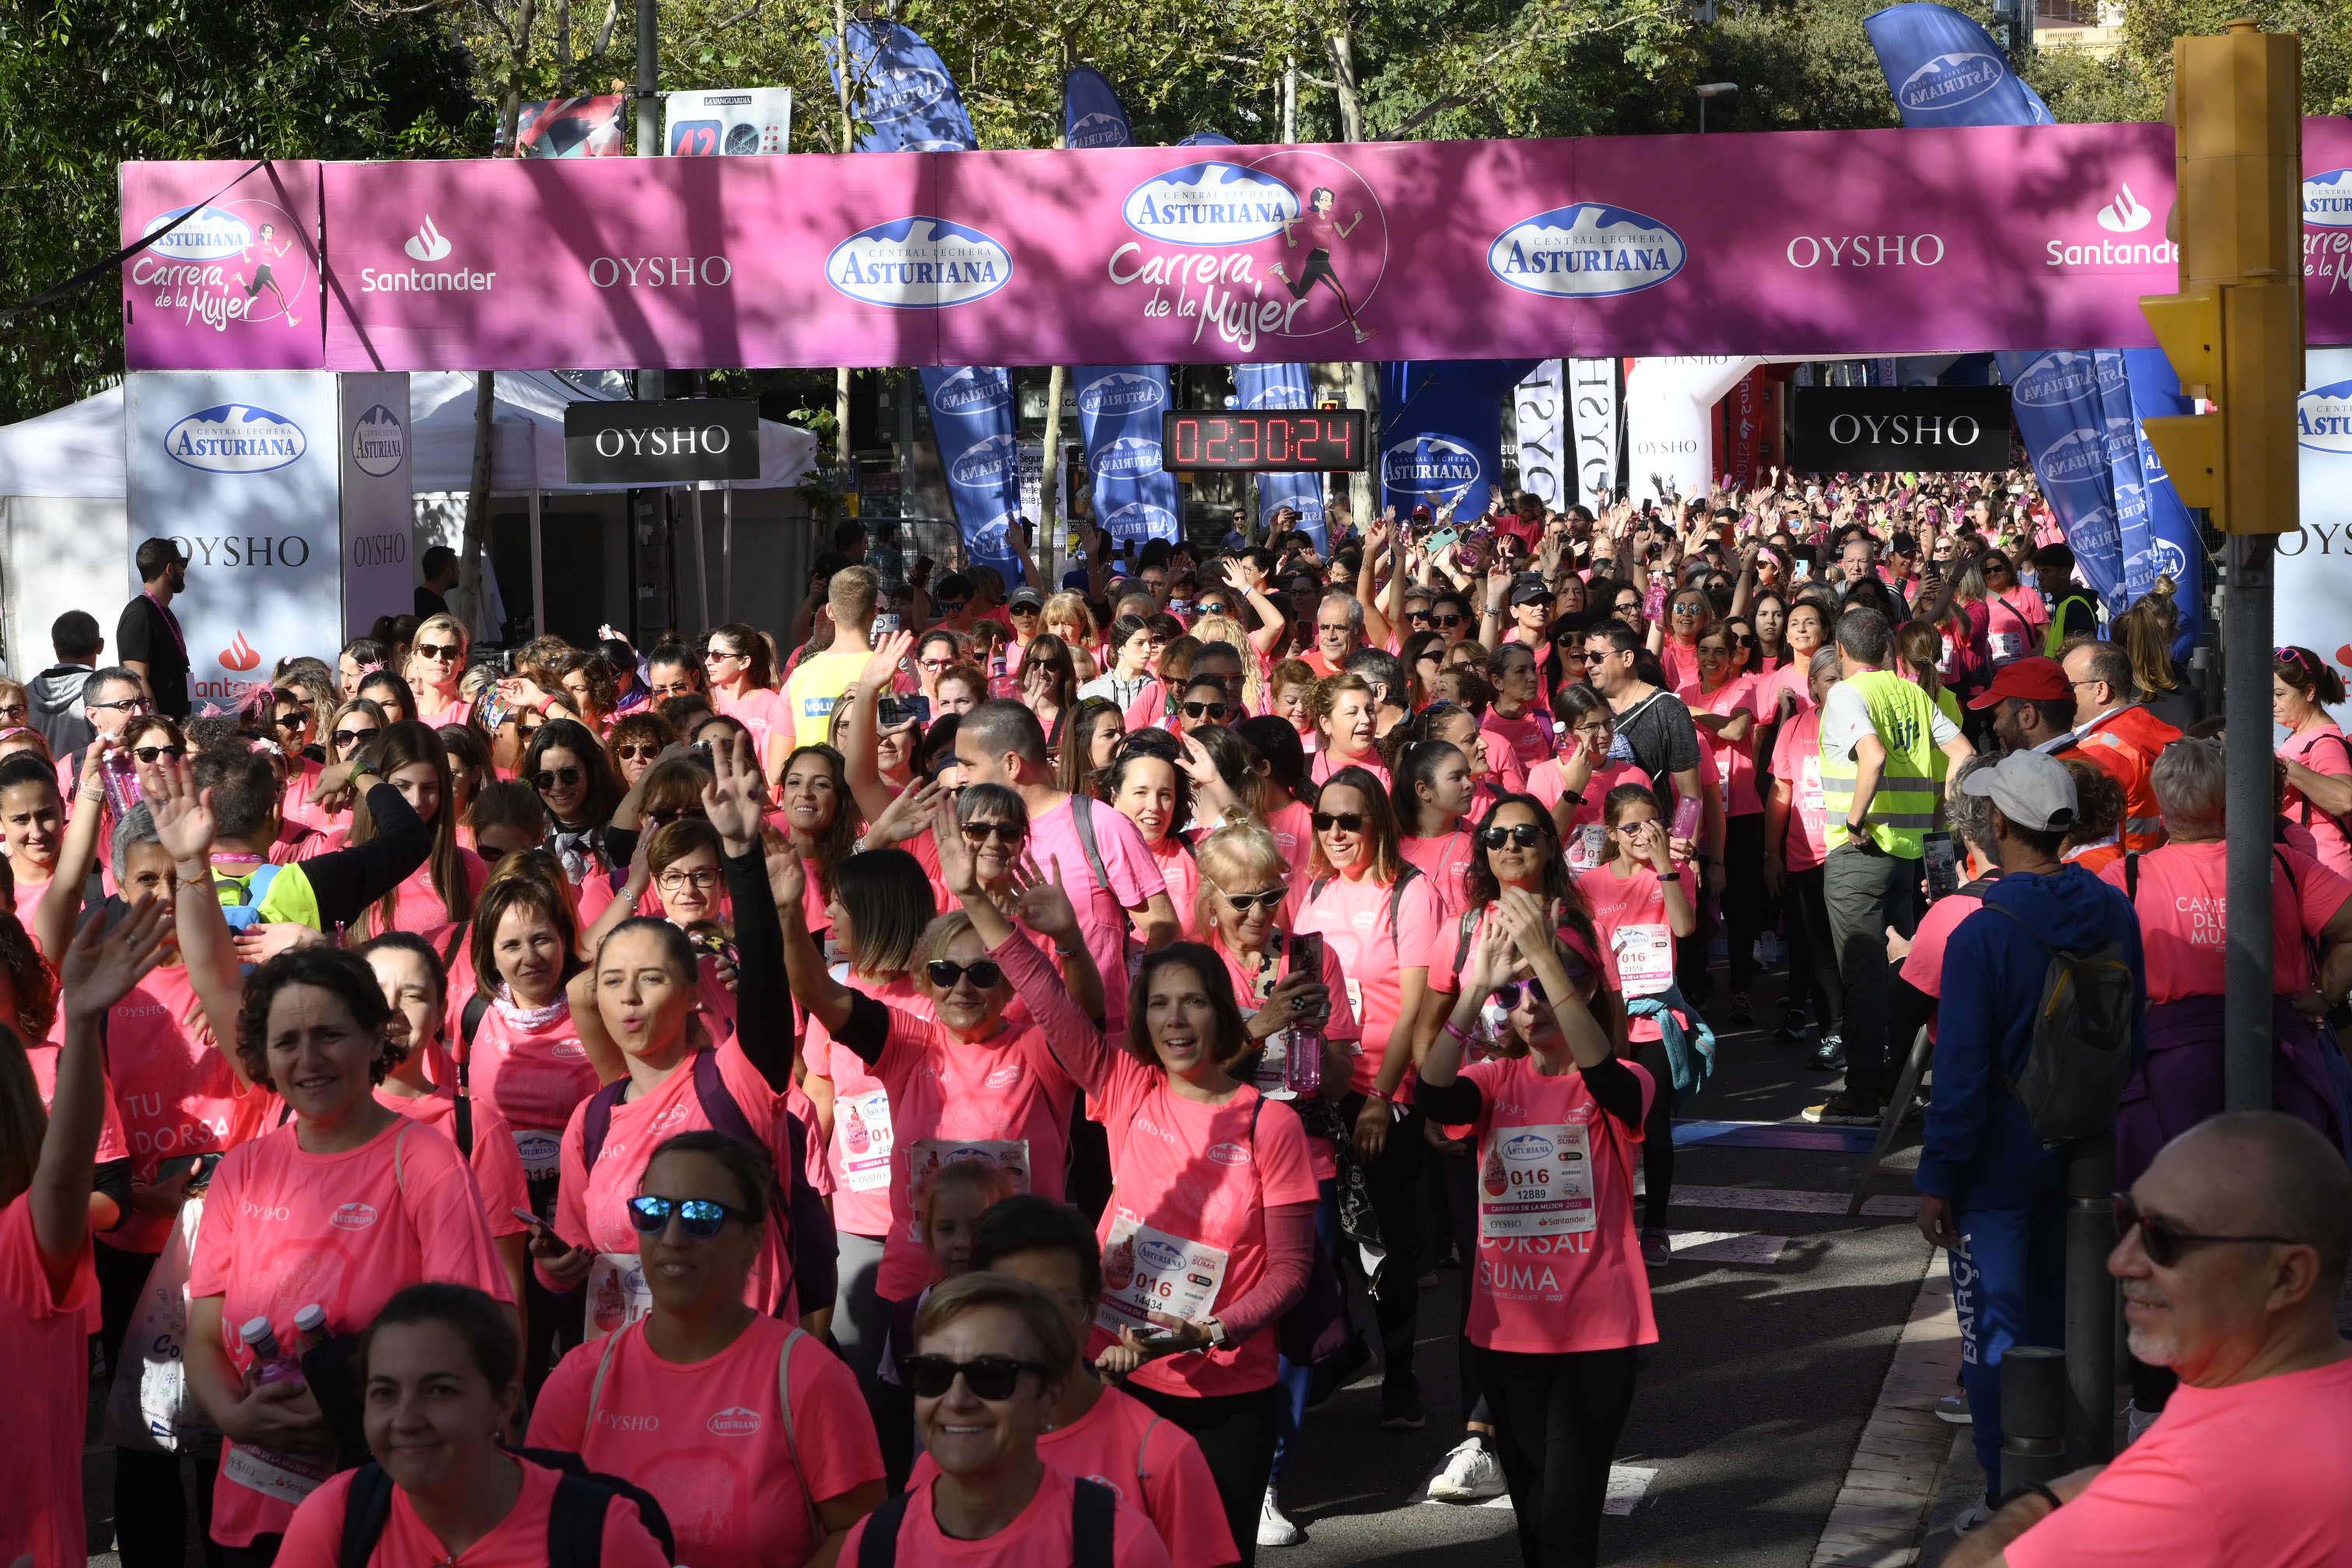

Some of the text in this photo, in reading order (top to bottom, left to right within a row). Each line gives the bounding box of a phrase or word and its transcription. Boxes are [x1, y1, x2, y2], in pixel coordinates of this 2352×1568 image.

[1137, 194, 1285, 225] ASTURIANA
[1164, 191, 1219, 201] CENTRAL
[868, 247, 992, 258] CENTRAL LECHERA
[1533, 234, 1664, 247] CENTRAL LECHERA
[1787, 233, 1945, 268] OYSHO
[840, 251, 997, 285] ASTURIANA
[1108, 241, 1254, 285] Carrera
[1503, 240, 1671, 275] ASTURIANA
[132, 257, 224, 286] Carrera
[361, 265, 497, 292] Santander
[589, 255, 732, 288] OYSHO
[156, 283, 259, 332] de la Mujer
[1144, 281, 1309, 352] de la Mujer
[176, 430, 297, 457] ASTURIANA
[596, 425, 730, 457] OYSHO
[1176, 419, 1350, 462] 02:30:24
[1829, 415, 1980, 446] OYSHO
[356, 431, 401, 459] ASTURIANA
[1638, 440, 1698, 455] OYSHO
[1387, 460, 1472, 481] ASTURIANA
[354, 533, 405, 567] OYSHO
[2191, 929, 2226, 944] MU
[1622, 953, 1646, 964] 016
[118, 1003, 168, 1018] OYSHO
[125, 1092, 162, 1119] TU
[1506, 1145, 1549, 1156] ASTURIANA
[1510, 1169, 1549, 1186] 016
[1517, 1189, 1546, 1200] 12889
[1490, 1216, 1587, 1229] OYSHO Santander
[1139, 1245, 1182, 1269] ASTURIANA
[1192, 1258, 1216, 1270] SUMA
[1136, 1272, 1173, 1297] 016
[1480, 1261, 1559, 1292] SUMA
[1134, 1293, 1162, 1311] 14434
[1947, 1233, 1979, 1366] BARÇA
[597, 1409, 660, 1431] OYSHO
[712, 1418, 761, 1430] ASTURIANA
